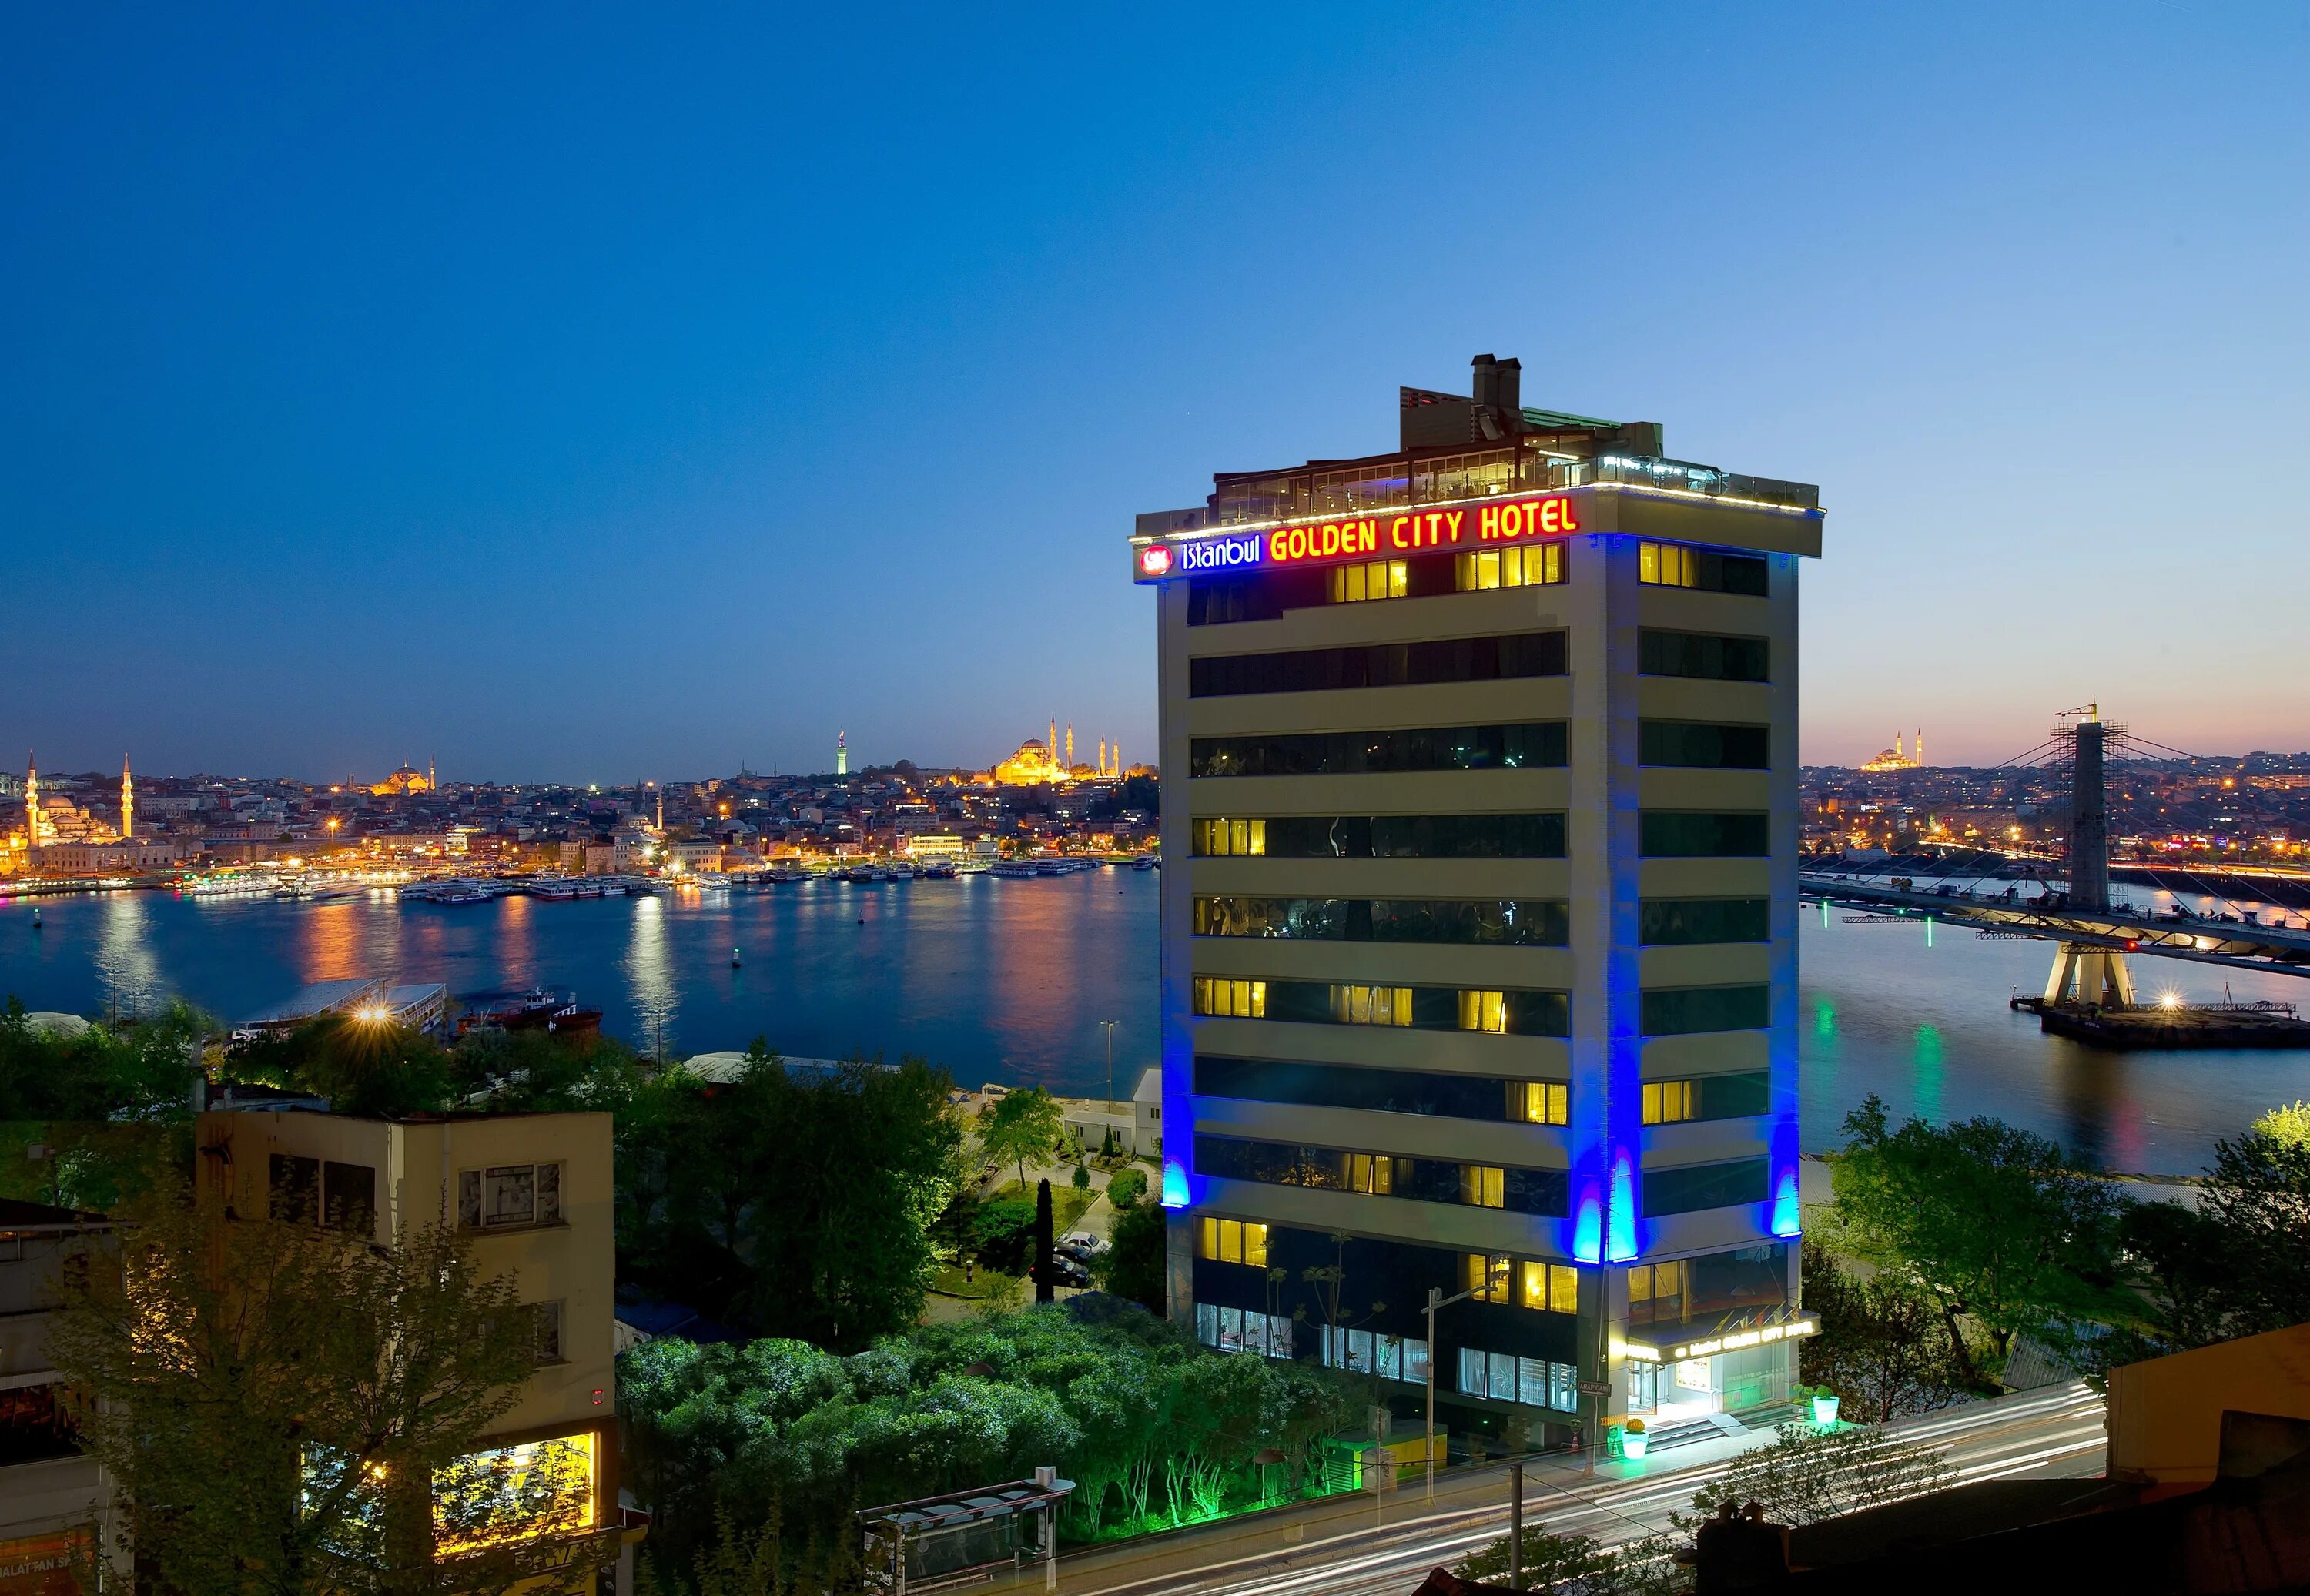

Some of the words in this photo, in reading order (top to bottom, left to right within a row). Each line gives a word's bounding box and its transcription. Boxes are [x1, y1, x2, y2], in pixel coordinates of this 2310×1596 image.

[1270, 520, 1376, 560] GOLDEN
[1392, 510, 1464, 548] CITY
[1481, 498, 1577, 540] HOTEL
[1579, 1383, 1595, 1391] ARAP
